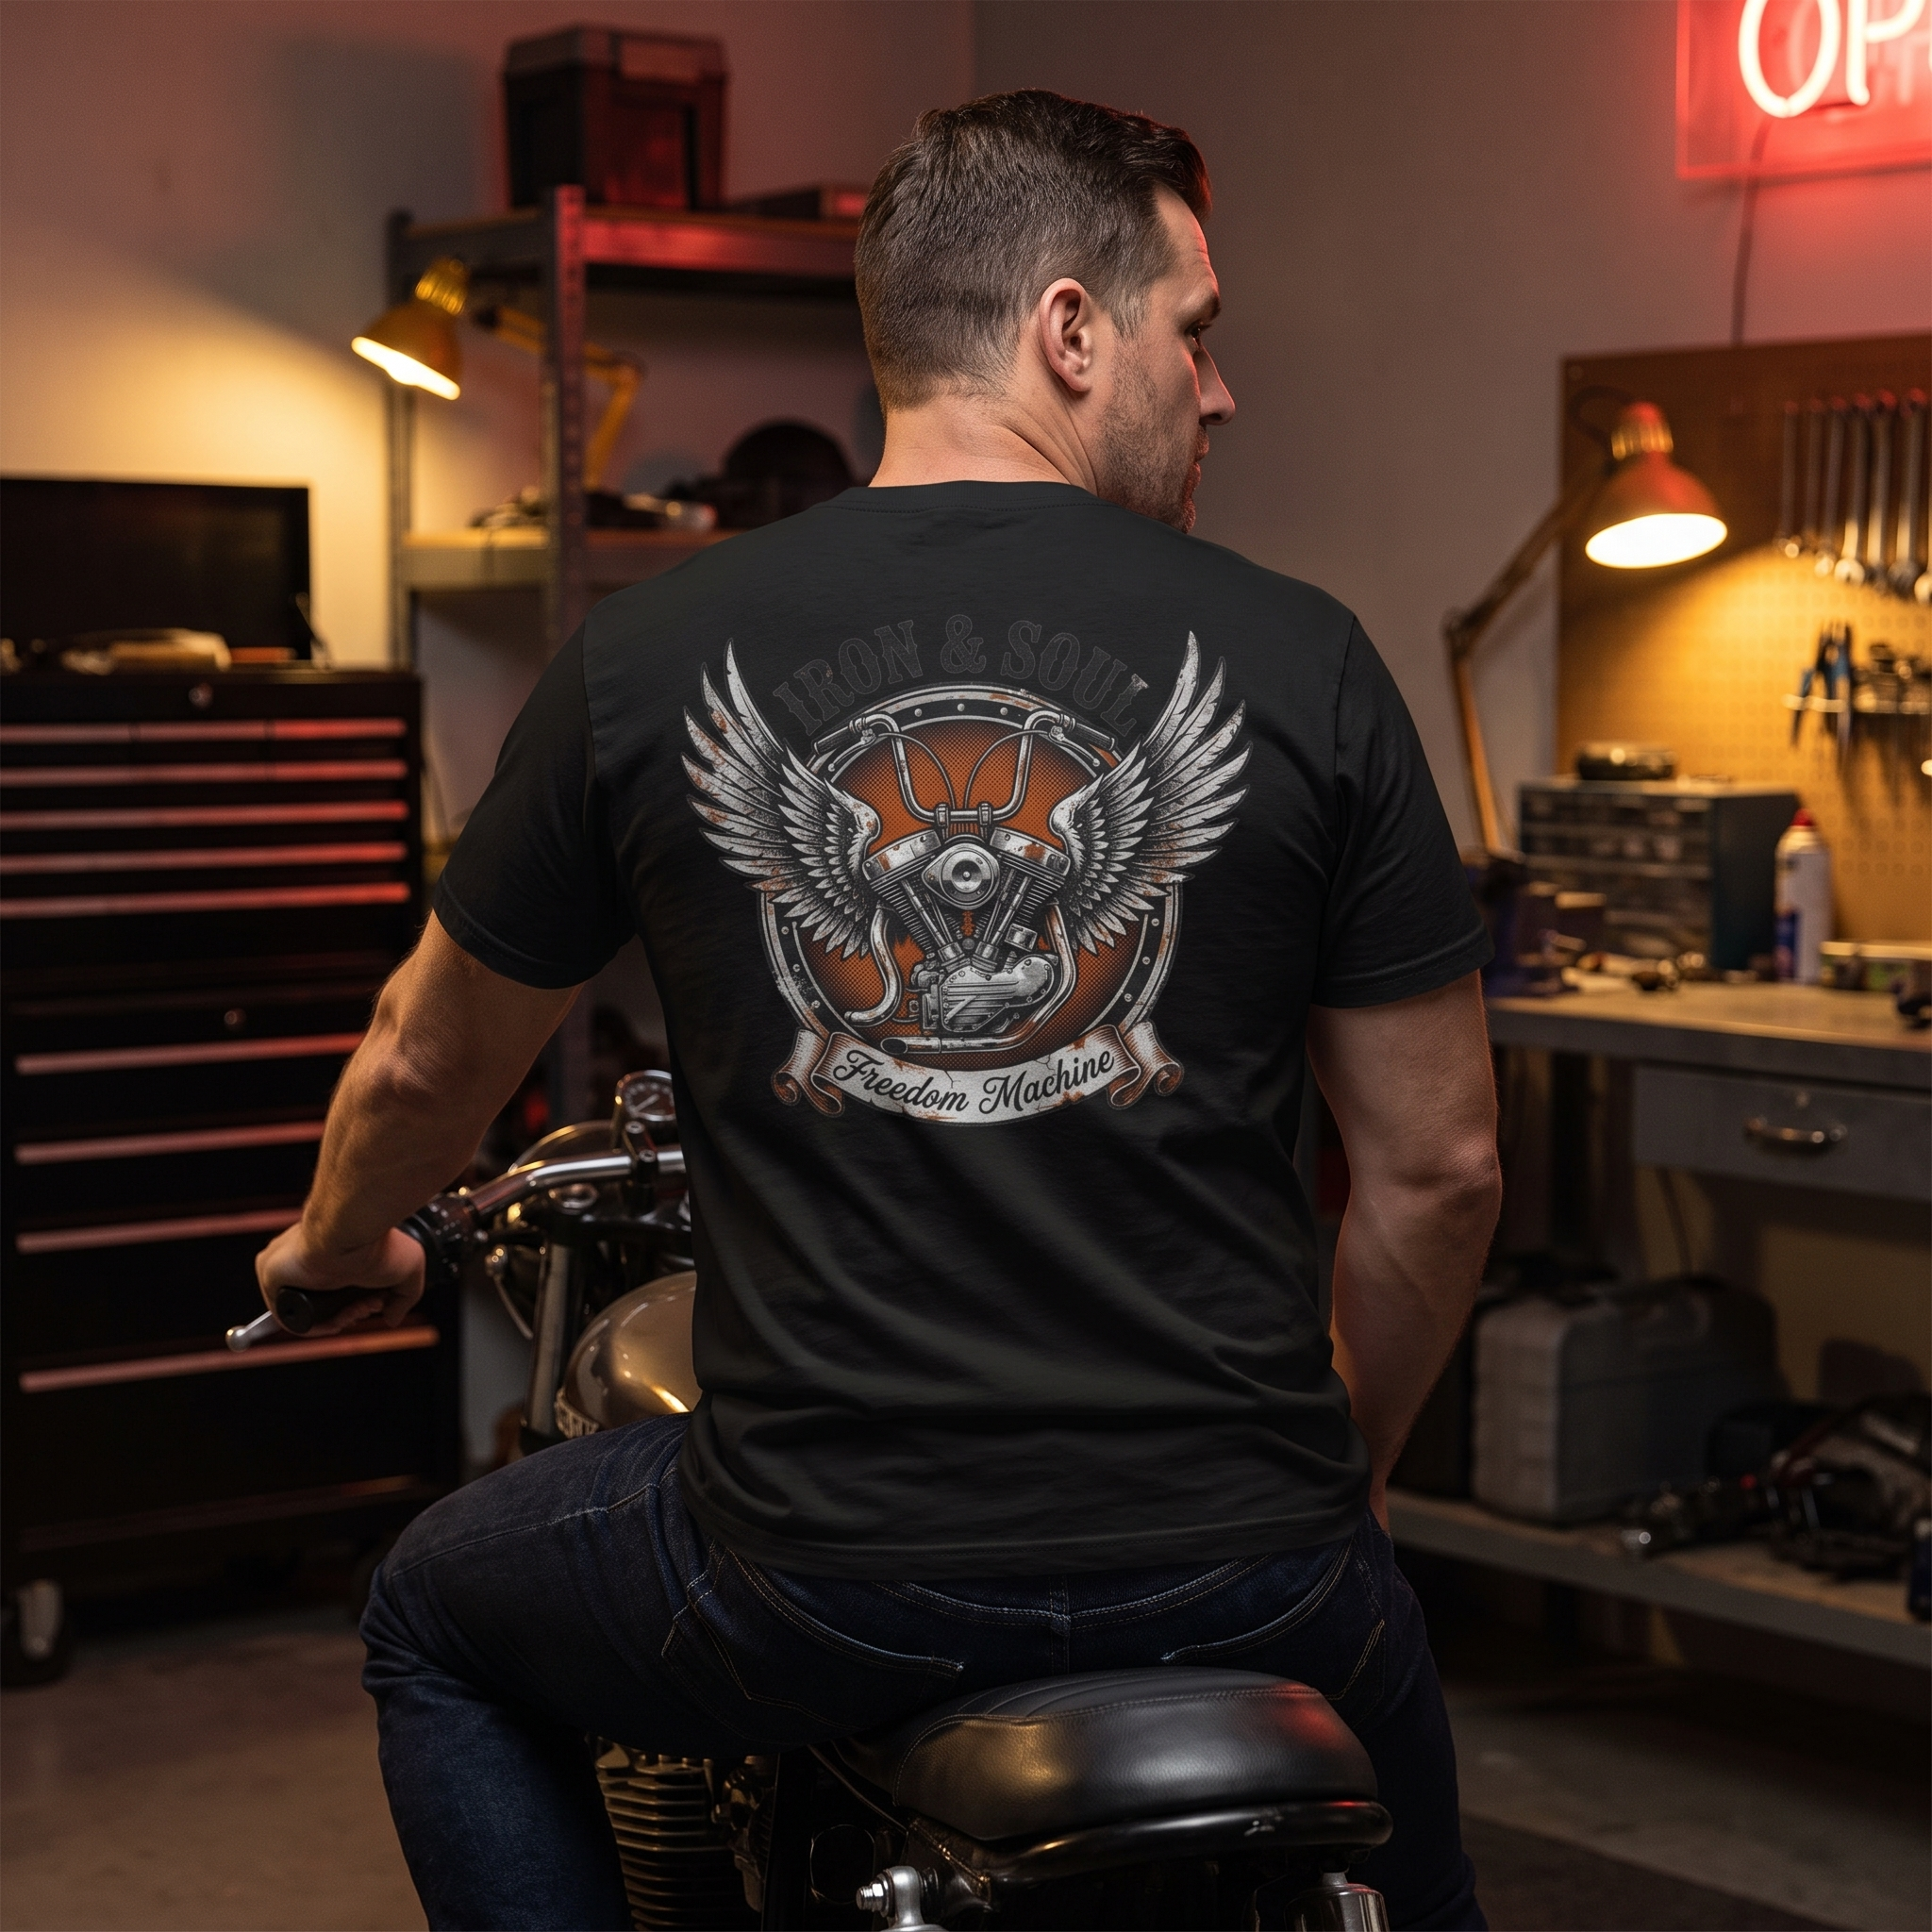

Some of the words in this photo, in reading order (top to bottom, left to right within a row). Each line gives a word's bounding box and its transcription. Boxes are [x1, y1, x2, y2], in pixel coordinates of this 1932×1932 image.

[1738, 0, 1932, 119] OP
[773, 620, 924, 736] IRON
[940, 614, 986, 675] &
[1000, 620, 1150, 737] SOUL
[832, 1049, 969, 1112] Freedom
[978, 1050, 1115, 1114] Machine
